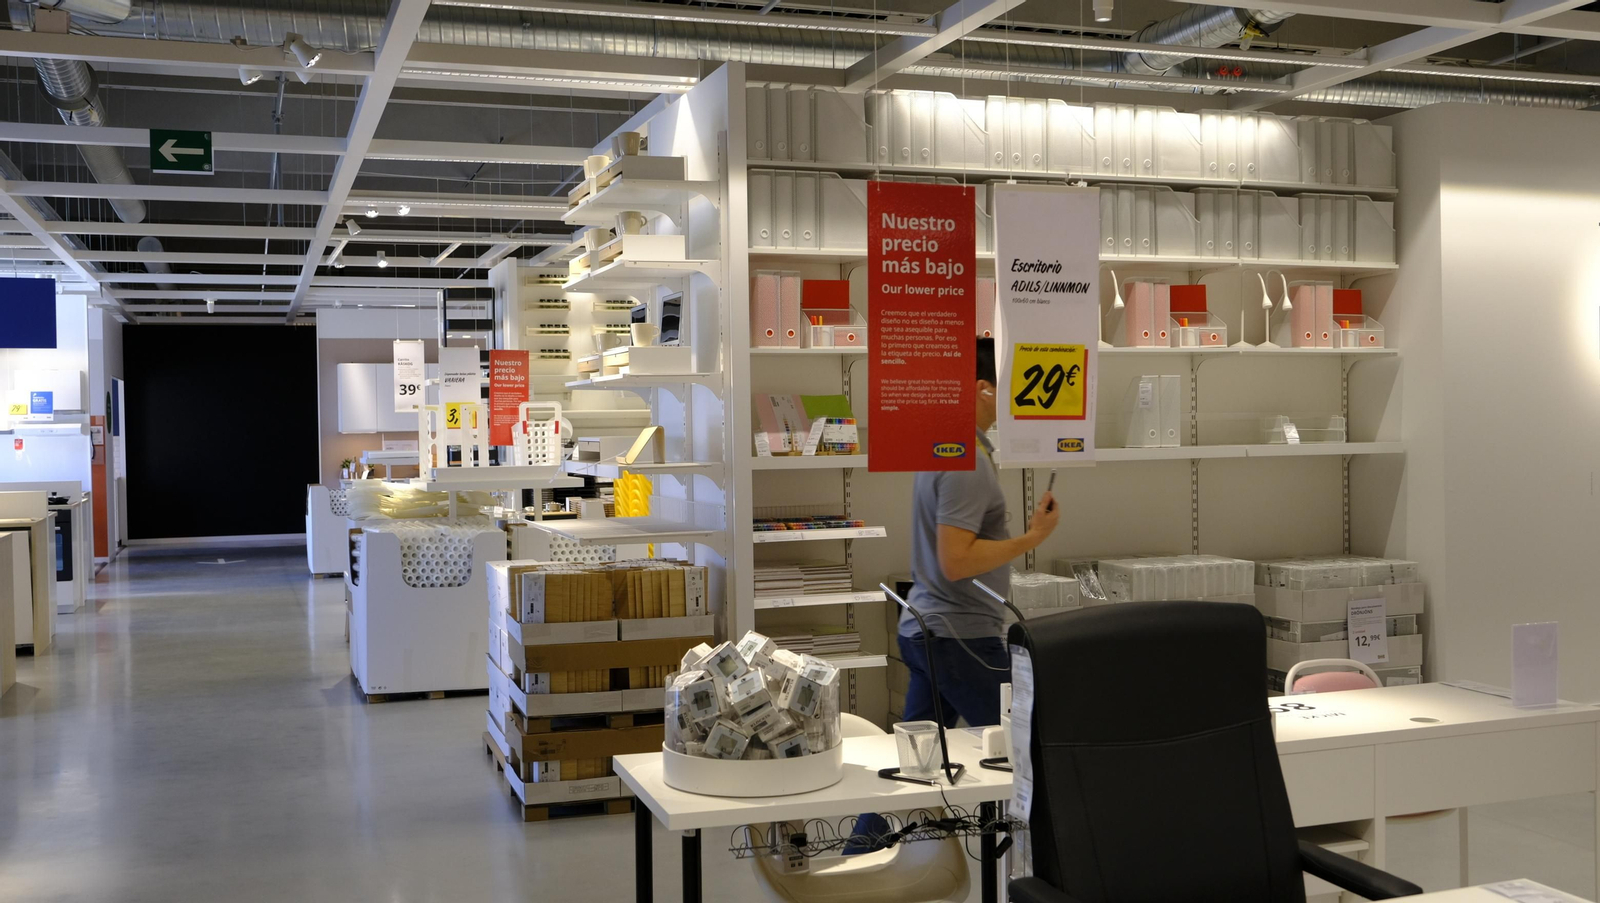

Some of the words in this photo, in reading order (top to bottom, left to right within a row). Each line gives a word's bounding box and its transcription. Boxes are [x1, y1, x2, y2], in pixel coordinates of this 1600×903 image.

[882, 212, 956, 232] Nuestro
[882, 235, 939, 256] precio
[882, 256, 920, 274] más
[925, 257, 965, 280] bajo
[1011, 258, 1063, 275] Escritorio
[881, 283, 903, 294] Our
[905, 284, 936, 295] lower
[938, 285, 965, 298] price
[1011, 279, 1091, 295] ADILS/LINNMON
[880, 317, 901, 325] diseño
[918, 318, 939, 326] diseño
[927, 310, 957, 318] verdadero
[905, 326, 933, 334] asequible
[887, 351, 912, 359] etiqueta
[921, 351, 941, 359] precio.
[510, 374, 525, 382] bajo
[936, 379, 961, 387] furnishing
[1014, 363, 1081, 410] 29€
